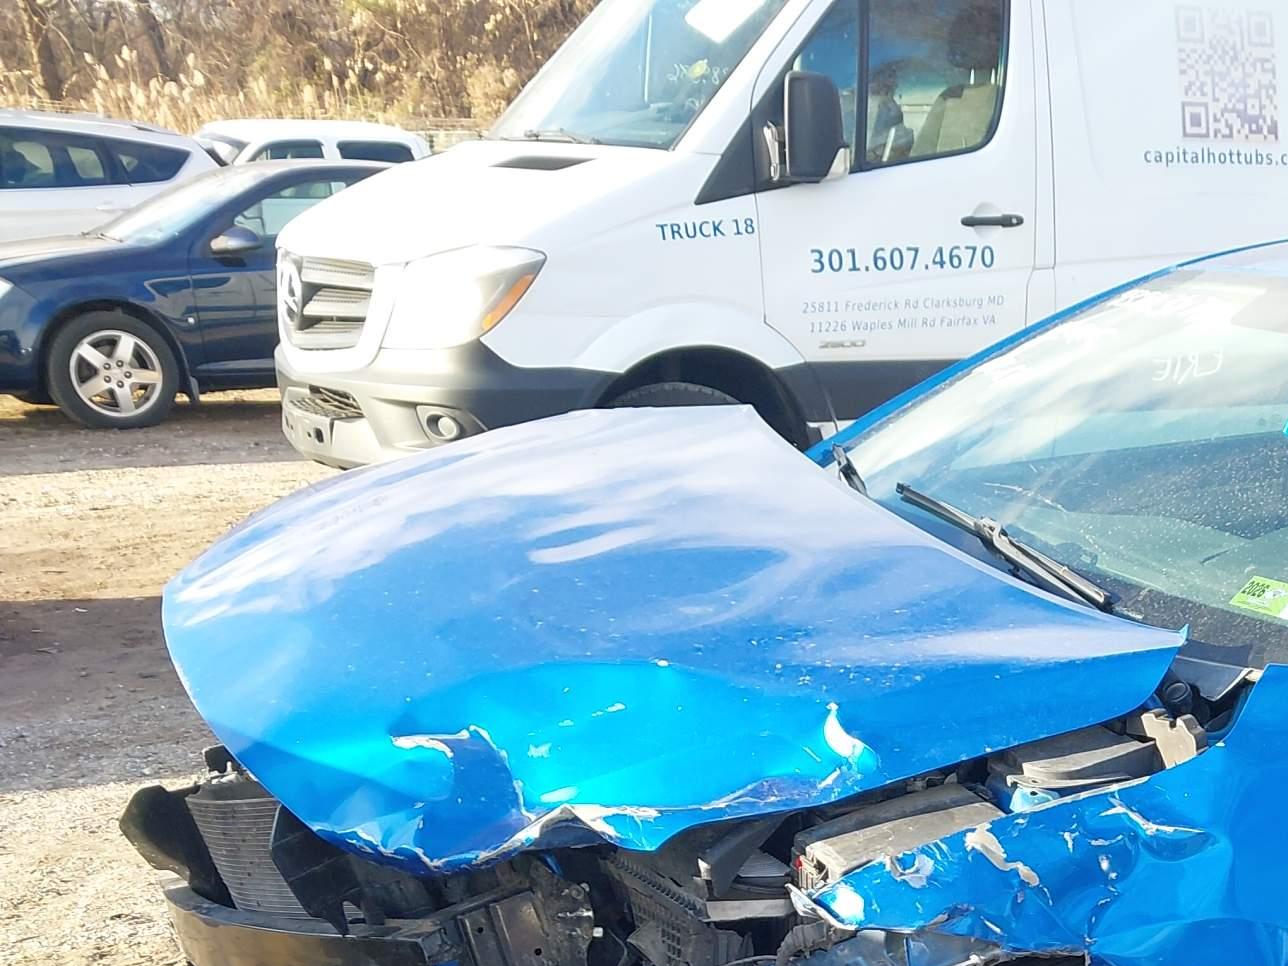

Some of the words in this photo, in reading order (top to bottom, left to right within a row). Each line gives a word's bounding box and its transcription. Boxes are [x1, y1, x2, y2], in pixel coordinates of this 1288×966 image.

[656, 219, 726, 241] TRUCK
[732, 217, 756, 236] 18
[809, 245, 996, 273] 301.607.4670
[802, 300, 840, 315] 25811
[844, 298, 900, 313] Frederick
[904, 297, 920, 310] Rd
[923, 296, 984, 310] Clarksburg
[987, 295, 1005, 306] MD
[810, 320, 848, 333] 11226
[852, 319, 894, 332] Waples
[897, 317, 918, 330] Mill
[921, 316, 936, 328] Rd
[939, 315, 979, 328] Fairfax
[982, 314, 997, 325] VA
